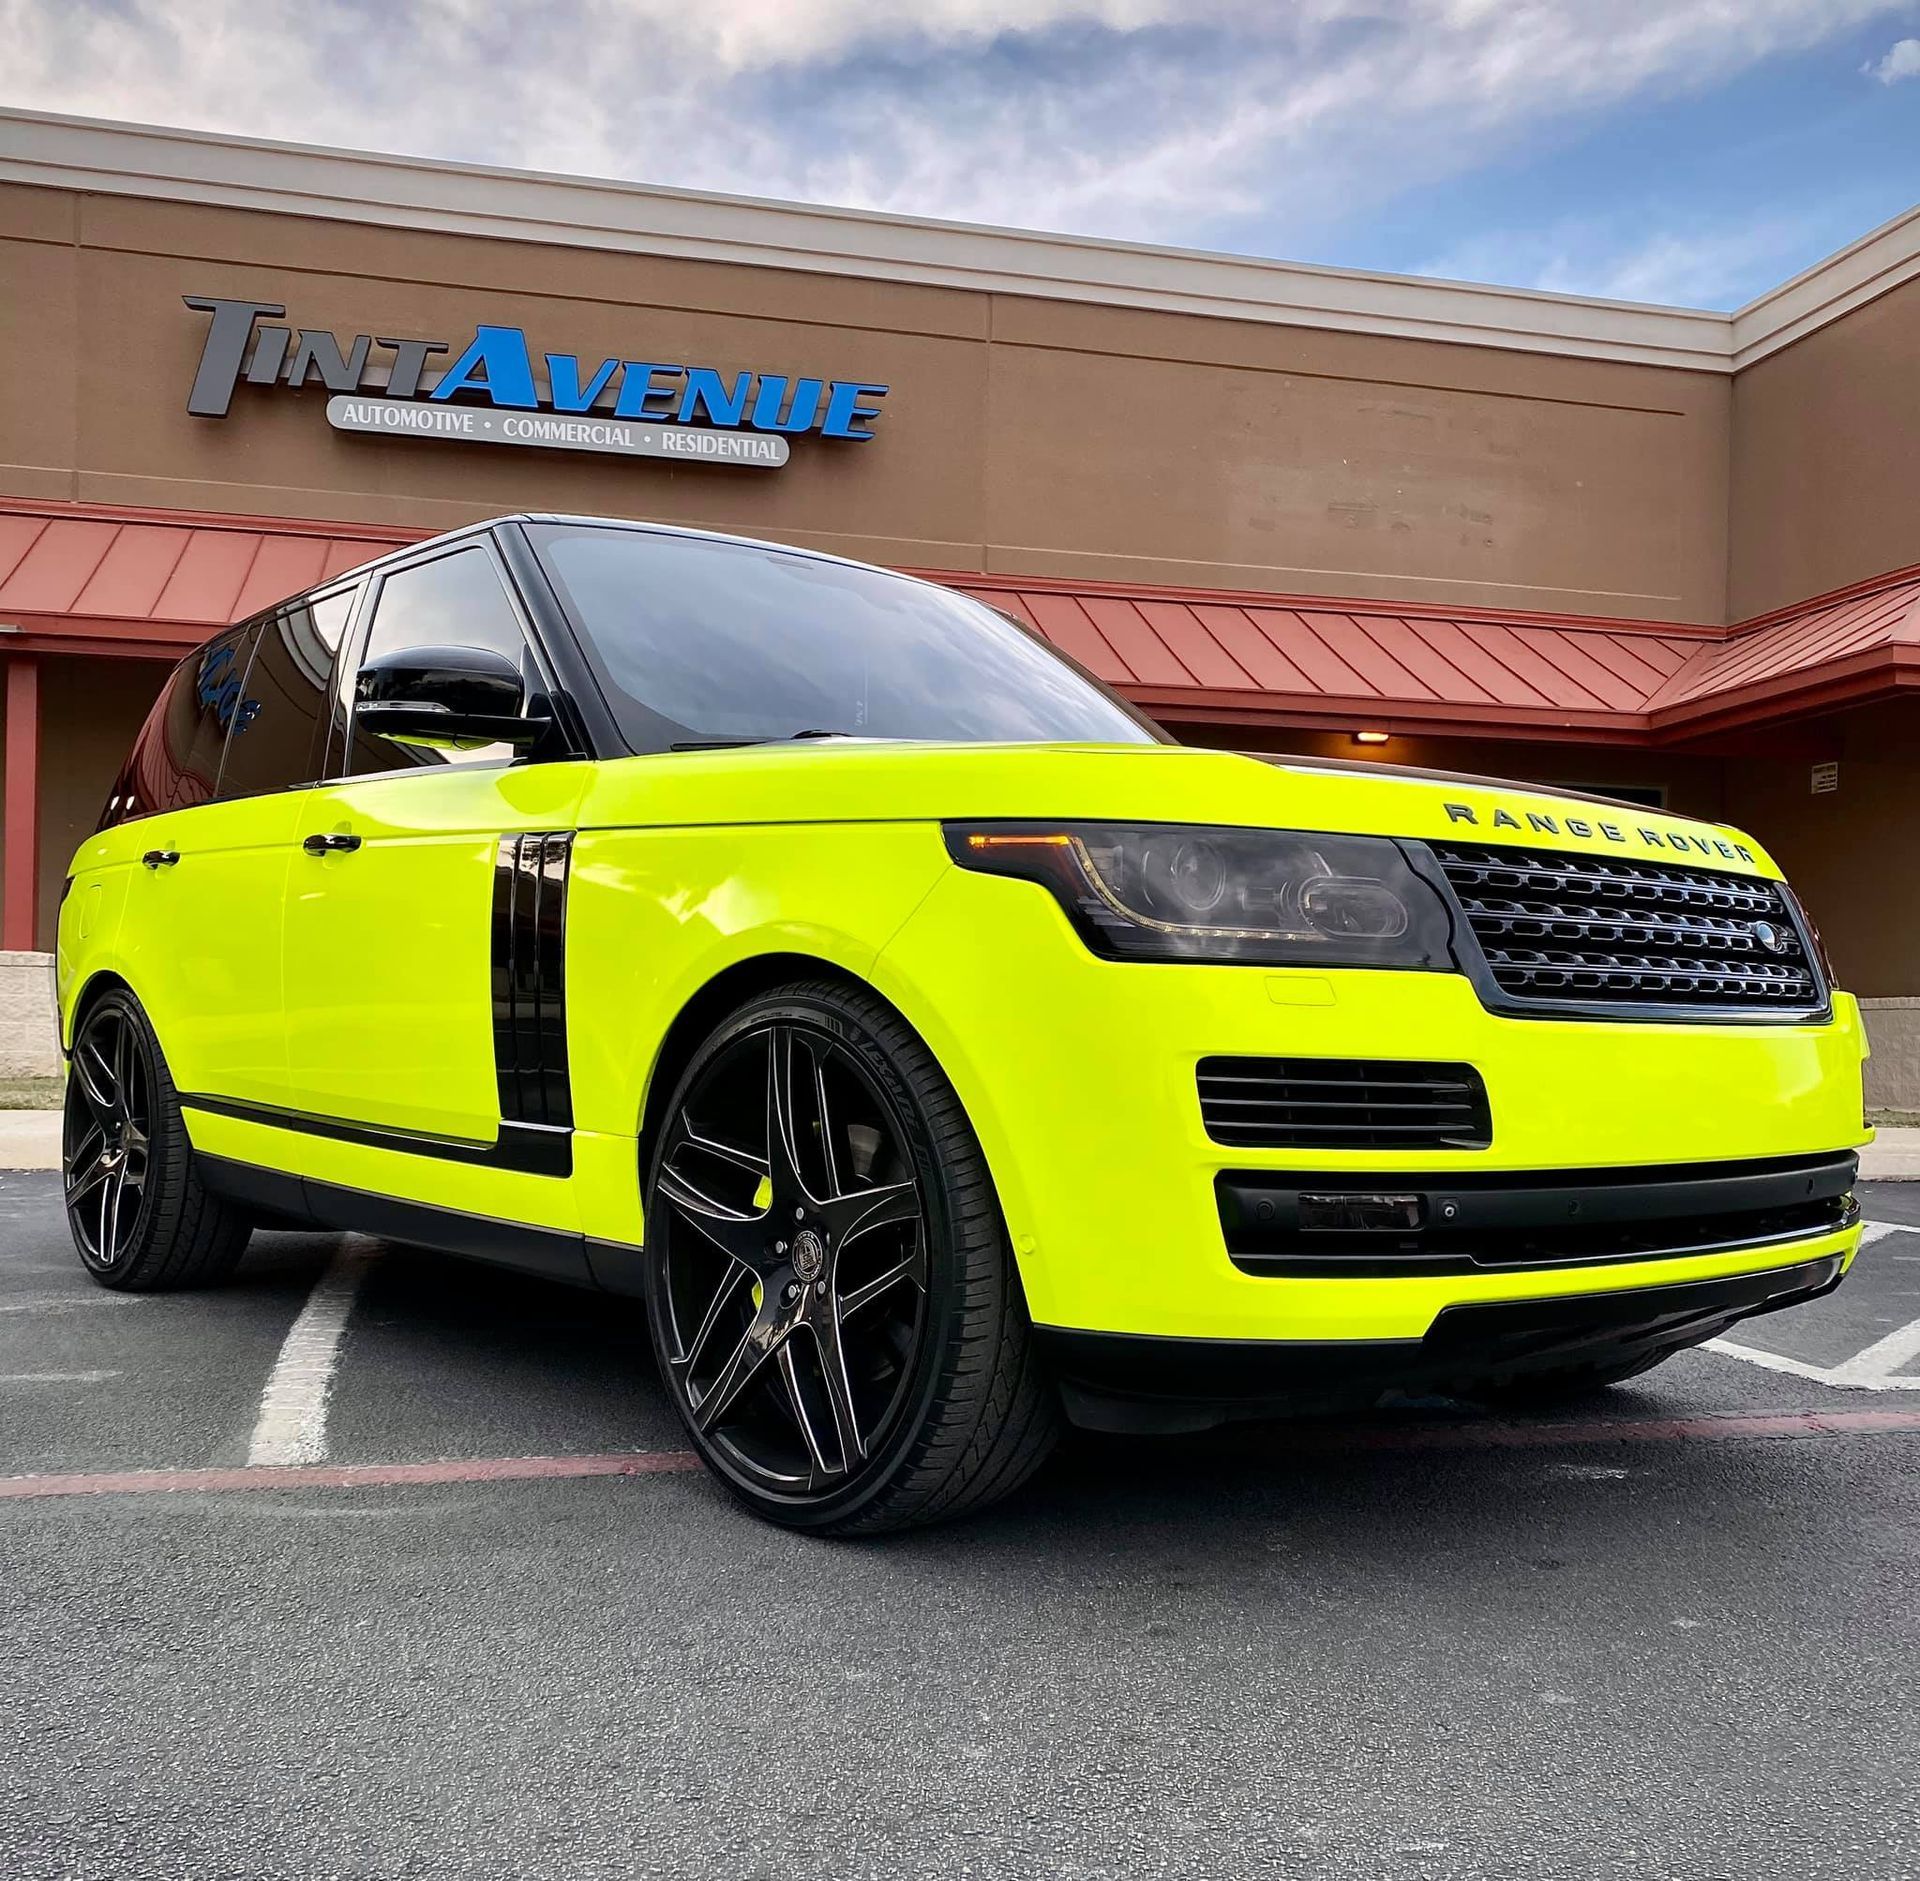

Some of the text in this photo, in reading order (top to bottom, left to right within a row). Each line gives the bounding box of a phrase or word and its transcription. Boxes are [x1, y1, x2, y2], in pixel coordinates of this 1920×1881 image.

[342, 402, 781, 461] AUTOMOTIVE COMMERCIAL RESIDENTIAL
[1443, 803, 1756, 864] RANGE ROVER
